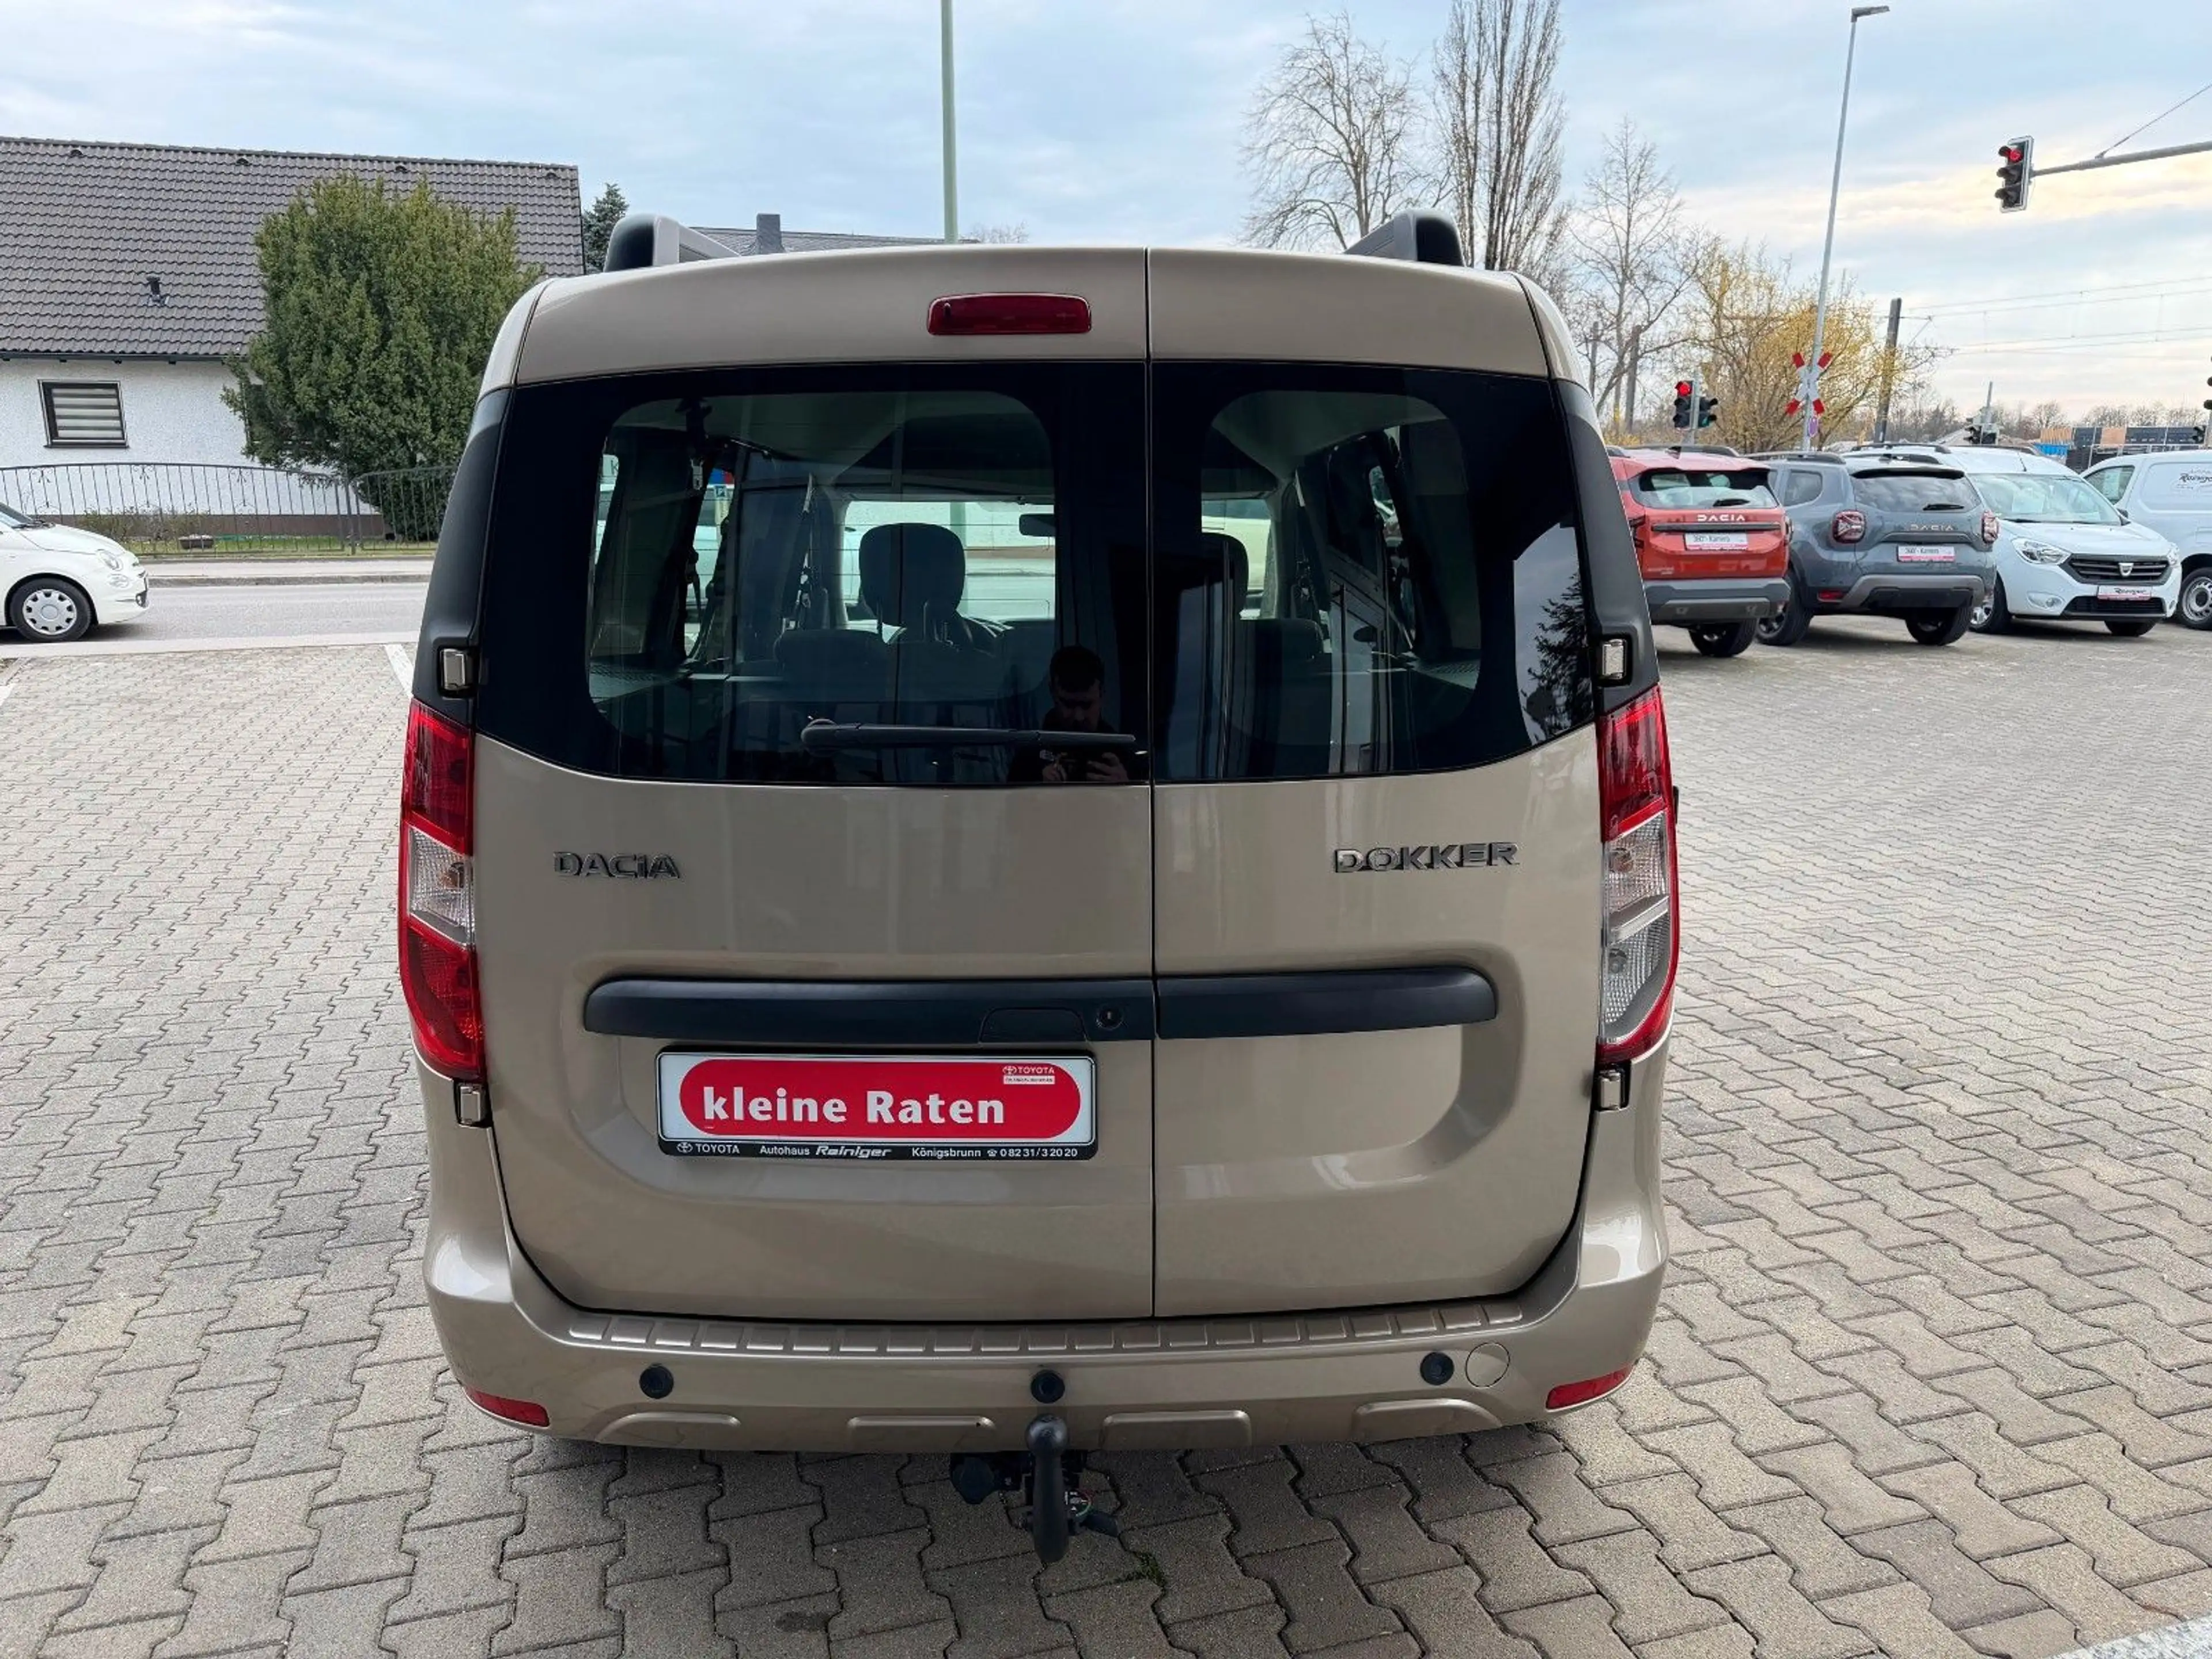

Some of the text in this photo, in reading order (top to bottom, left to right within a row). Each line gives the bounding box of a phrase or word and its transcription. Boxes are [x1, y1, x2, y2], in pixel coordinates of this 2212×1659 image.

[1697, 514, 1745, 522] DACIA
[553, 851, 680, 880] DACIA
[1334, 842, 1520, 873] DOKKER
[1018, 1066, 1055, 1074] TOYOTA
[703, 1086, 1004, 1124] kleine Raten
[695, 1143, 740, 1154] TOYOTA
[760, 1145, 810, 1156] Autohaus
[912, 1147, 981, 1159] Königsbrunn
